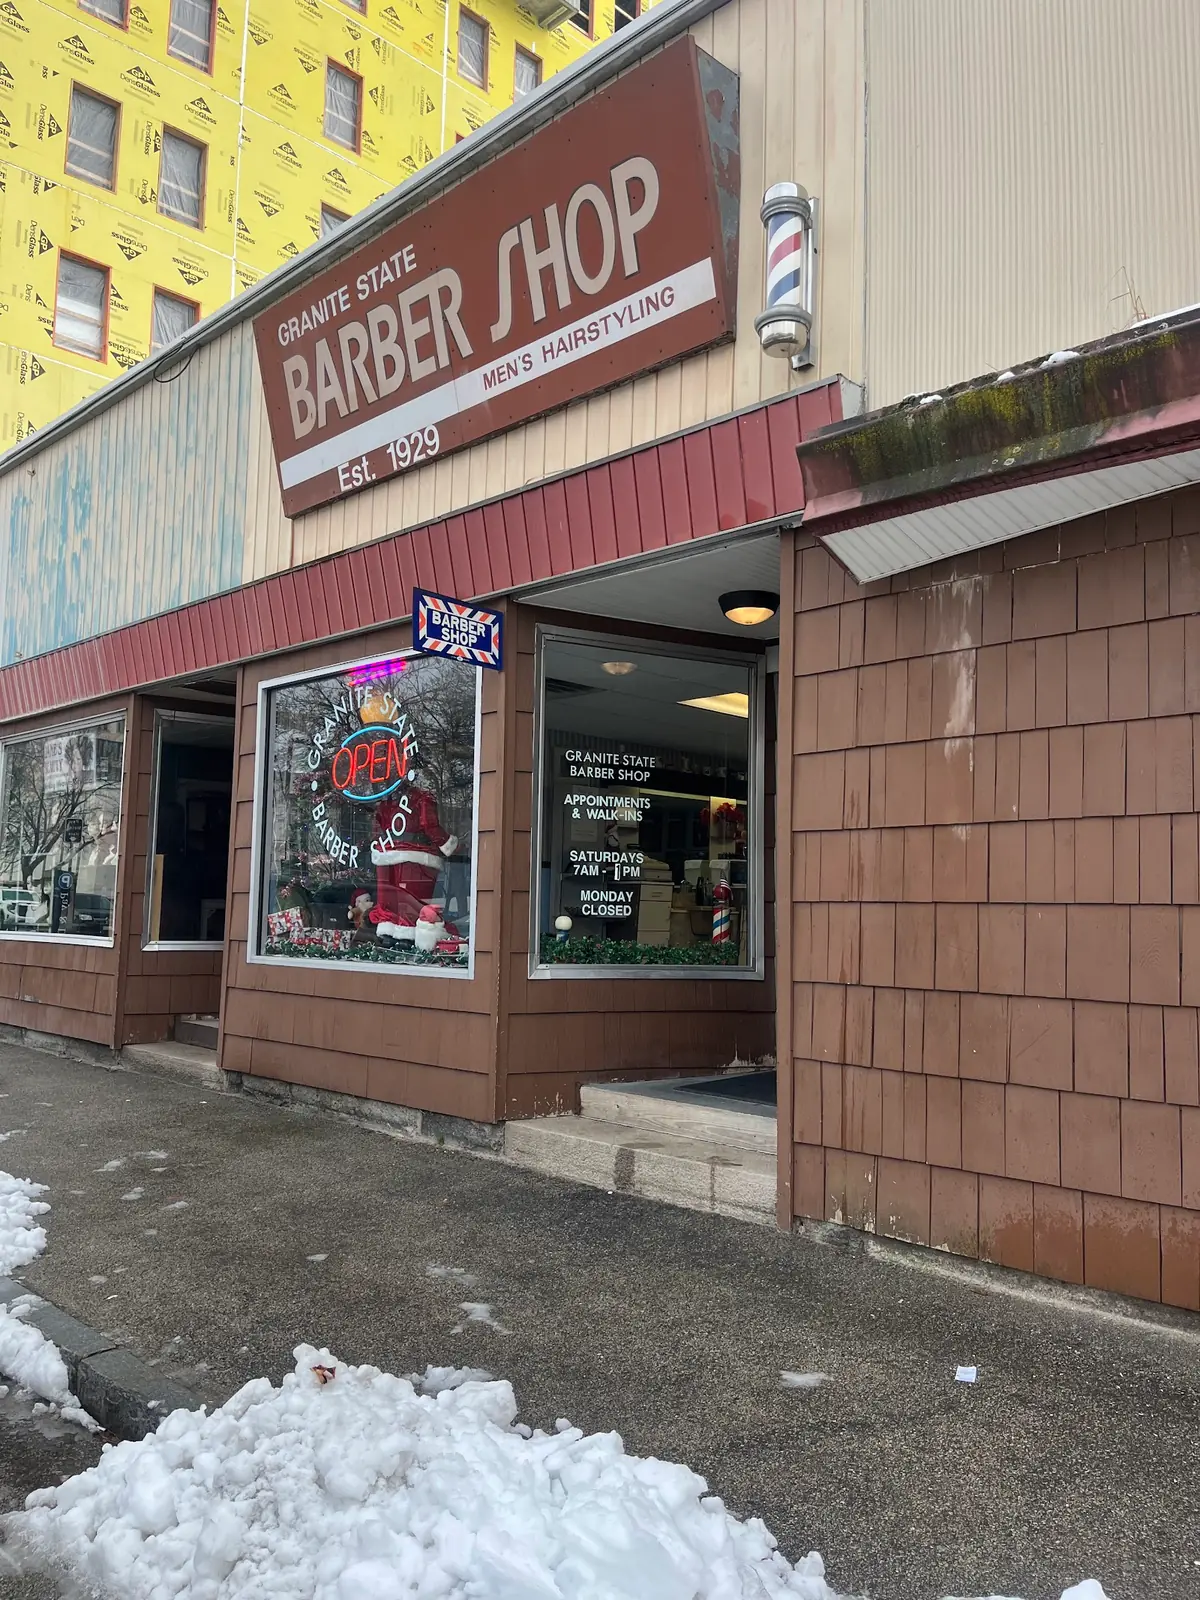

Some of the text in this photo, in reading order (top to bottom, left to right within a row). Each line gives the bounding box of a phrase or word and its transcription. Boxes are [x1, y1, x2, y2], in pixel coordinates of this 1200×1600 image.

[57, 42, 95, 65] DensGlass
[37, 104, 48, 140] DensGlass
[184, 104, 217, 125] DensGlass
[144, 121, 152, 156] DensGlass
[272, 149, 302, 168] DensGlass
[322, 174, 352, 194] DensGlass
[254, 190, 284, 210] DensGlass
[28, 220, 38, 258] DensGlass
[112, 231, 148, 252] DensGlass
[277, 244, 418, 348] GRANITE STATE
[282, 156, 660, 441] BARBER SHOP
[482, 285, 676, 391] MEN'S HAIRSTYLING
[337, 424, 441, 493] Est. 1929
[432, 610, 486, 638] BARBER
[441, 627, 478, 647] SHOP
[308, 686, 419, 770] GRANITE STATE
[332, 738, 409, 788] OPEN
[565, 750, 656, 768] GRANITE STATE
[570, 765, 651, 782] BARBER SHOP
[564, 794, 651, 809] APPOINTMENTS
[572, 808, 643, 822] & WALK-INS
[312, 795, 412, 868] BARBER SHOP
[569, 850, 644, 864] SATURDAYS
[573, 864, 599, 876] 7AM
[580, 890, 634, 902] MONDAY
[582, 904, 632, 916] CLOSED
